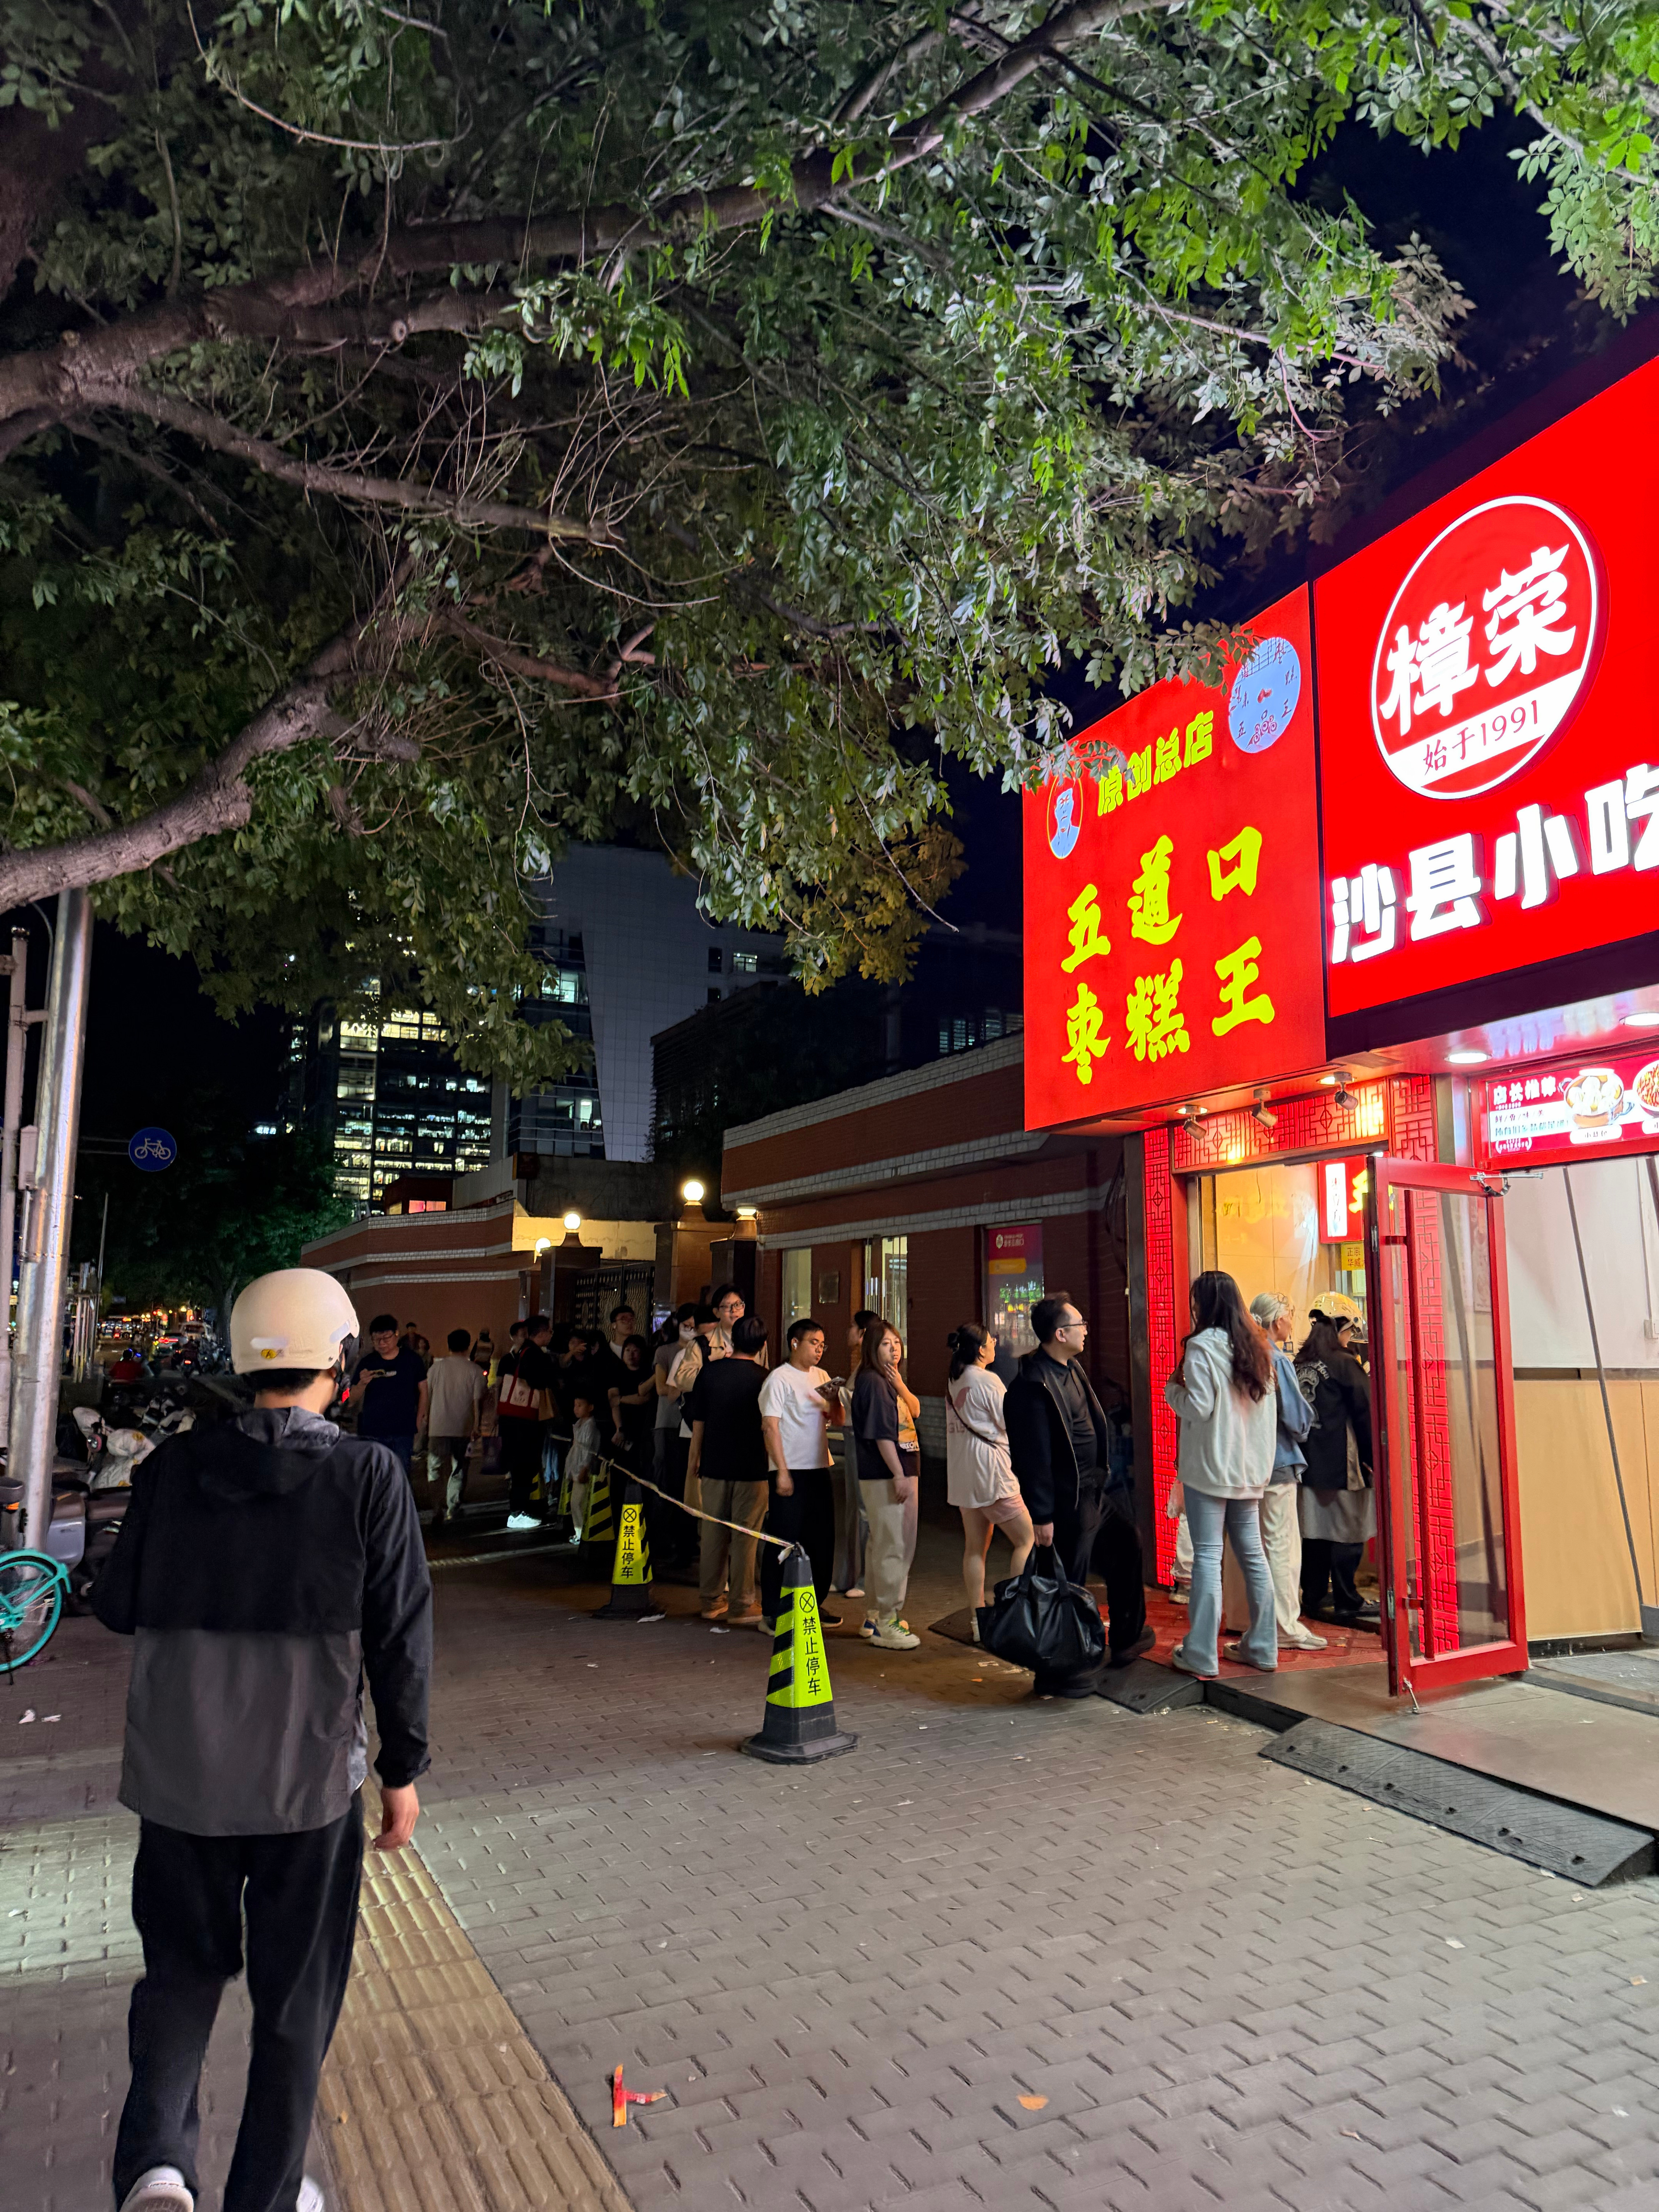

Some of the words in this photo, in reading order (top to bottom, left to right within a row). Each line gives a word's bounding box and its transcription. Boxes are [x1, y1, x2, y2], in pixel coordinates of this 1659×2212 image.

[1379, 543, 1576, 737] 樟荣
[1097, 710, 1214, 816] 原创总店
[1423, 700, 1537, 776] 始于1991
[1060, 826, 1263, 973] 五道口
[1331, 763, 1659, 963] 沙县小吃
[1061, 936, 1275, 1085] 枣糕王
[621, 1525, 635, 1578] 禁止停车
[803, 1616, 821, 1696] 禁止停车
